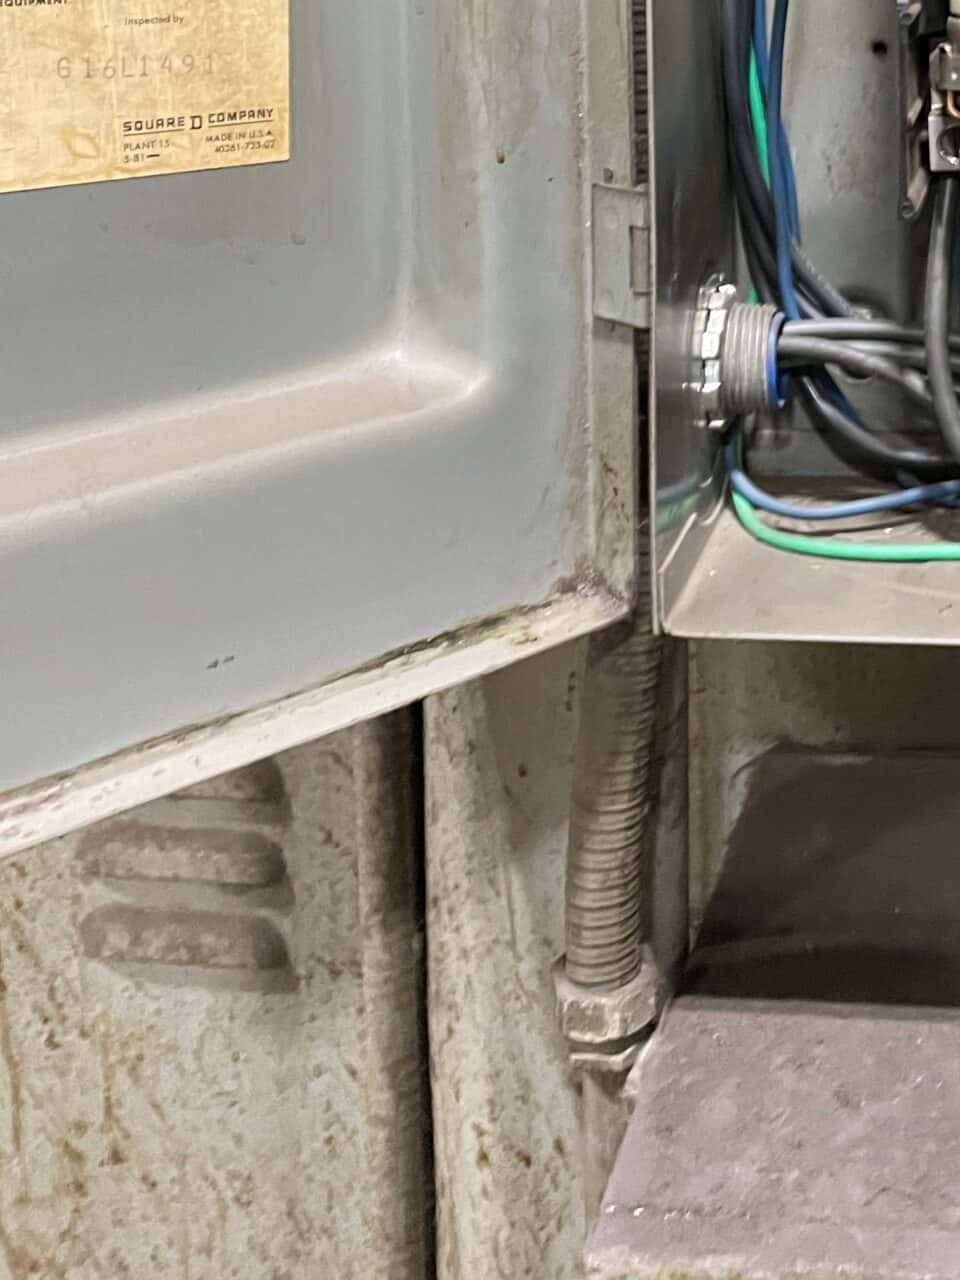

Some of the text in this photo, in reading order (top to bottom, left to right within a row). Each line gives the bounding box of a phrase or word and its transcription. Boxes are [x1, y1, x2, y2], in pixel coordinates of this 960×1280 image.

[122, 107, 274, 132] SQUARE D COMPANY
